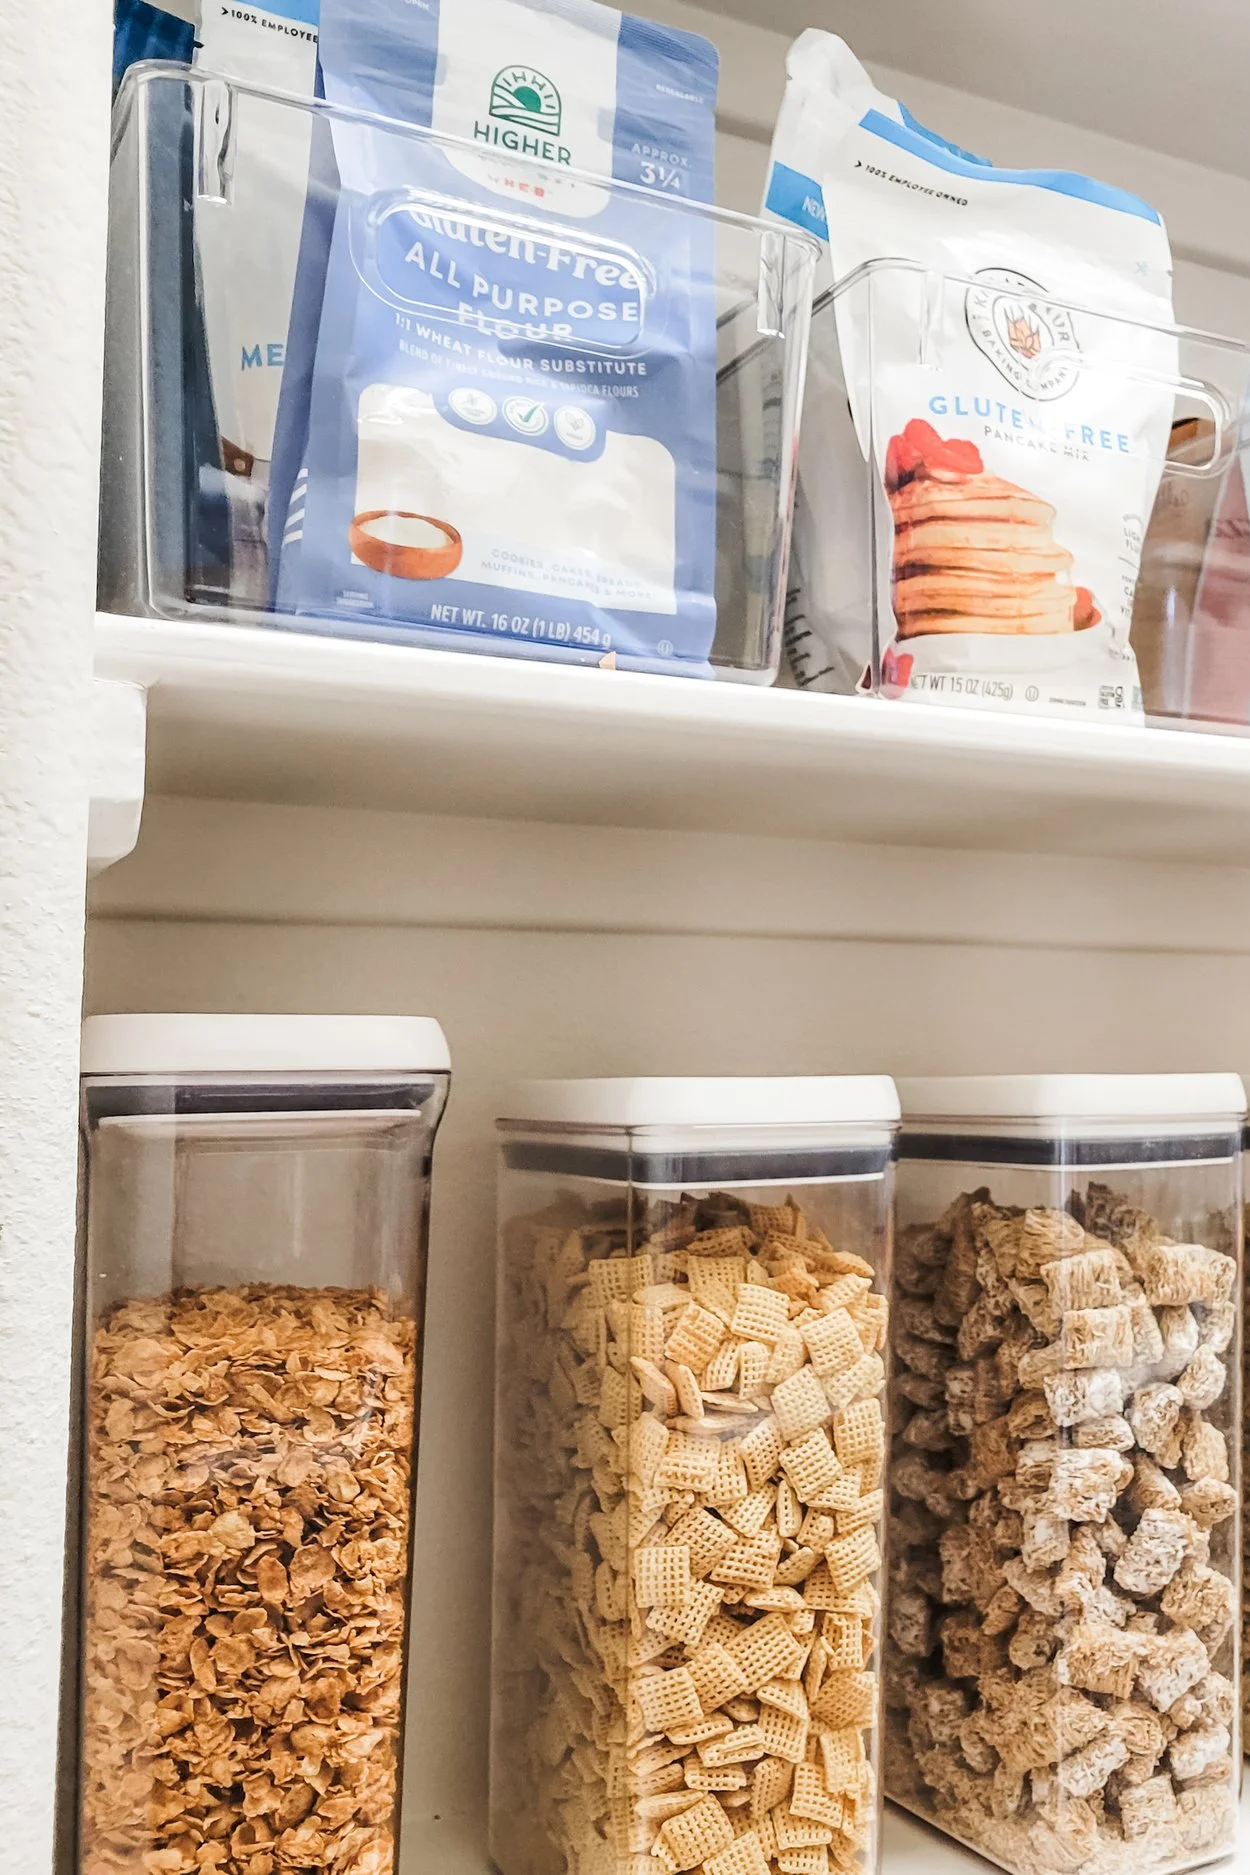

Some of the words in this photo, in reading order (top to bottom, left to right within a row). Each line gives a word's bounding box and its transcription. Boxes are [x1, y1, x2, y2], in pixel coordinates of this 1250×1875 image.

[231, 9, 258, 25] 100%
[261, 19, 319, 43] EMPLOYEE
[473, 120, 572, 167] HIGHER
[630, 142, 692, 169] APPROX.
[865, 164, 887, 179] 100%
[888, 174, 934, 197] EMPLOYEE
[935, 190, 968, 207] OWNED
[404, 241, 462, 289] ALL
[471, 272, 640, 323] PURPOSE
[457, 300, 574, 342] FLOUR
[399, 340, 430, 361] BLEND
[601, 383, 640, 399] FLOURS
[416, 325, 473, 360] WHEAT
[477, 349, 535, 373] FLOUR
[539, 358, 649, 377] SUBSTITUTE
[983, 425, 1058, 454] PANCAKE
[1065, 422, 1131, 454] FREE
[430, 603, 458, 623] NET
[462, 610, 487, 629] WT.
[491, 612, 508, 631] 16
[511, 617, 529, 636] OZ
[532, 618, 547, 638] (1
[547, 621, 570, 642] LB)
[572, 624, 600, 644] 454
[601, 633, 611, 650] g
[911, 675, 928, 691] ET
[930, 675, 946, 692] WT
[950, 676, 963, 693] 15
[965, 679, 980, 694] OZ
[982, 681, 1014, 701] (425g)
